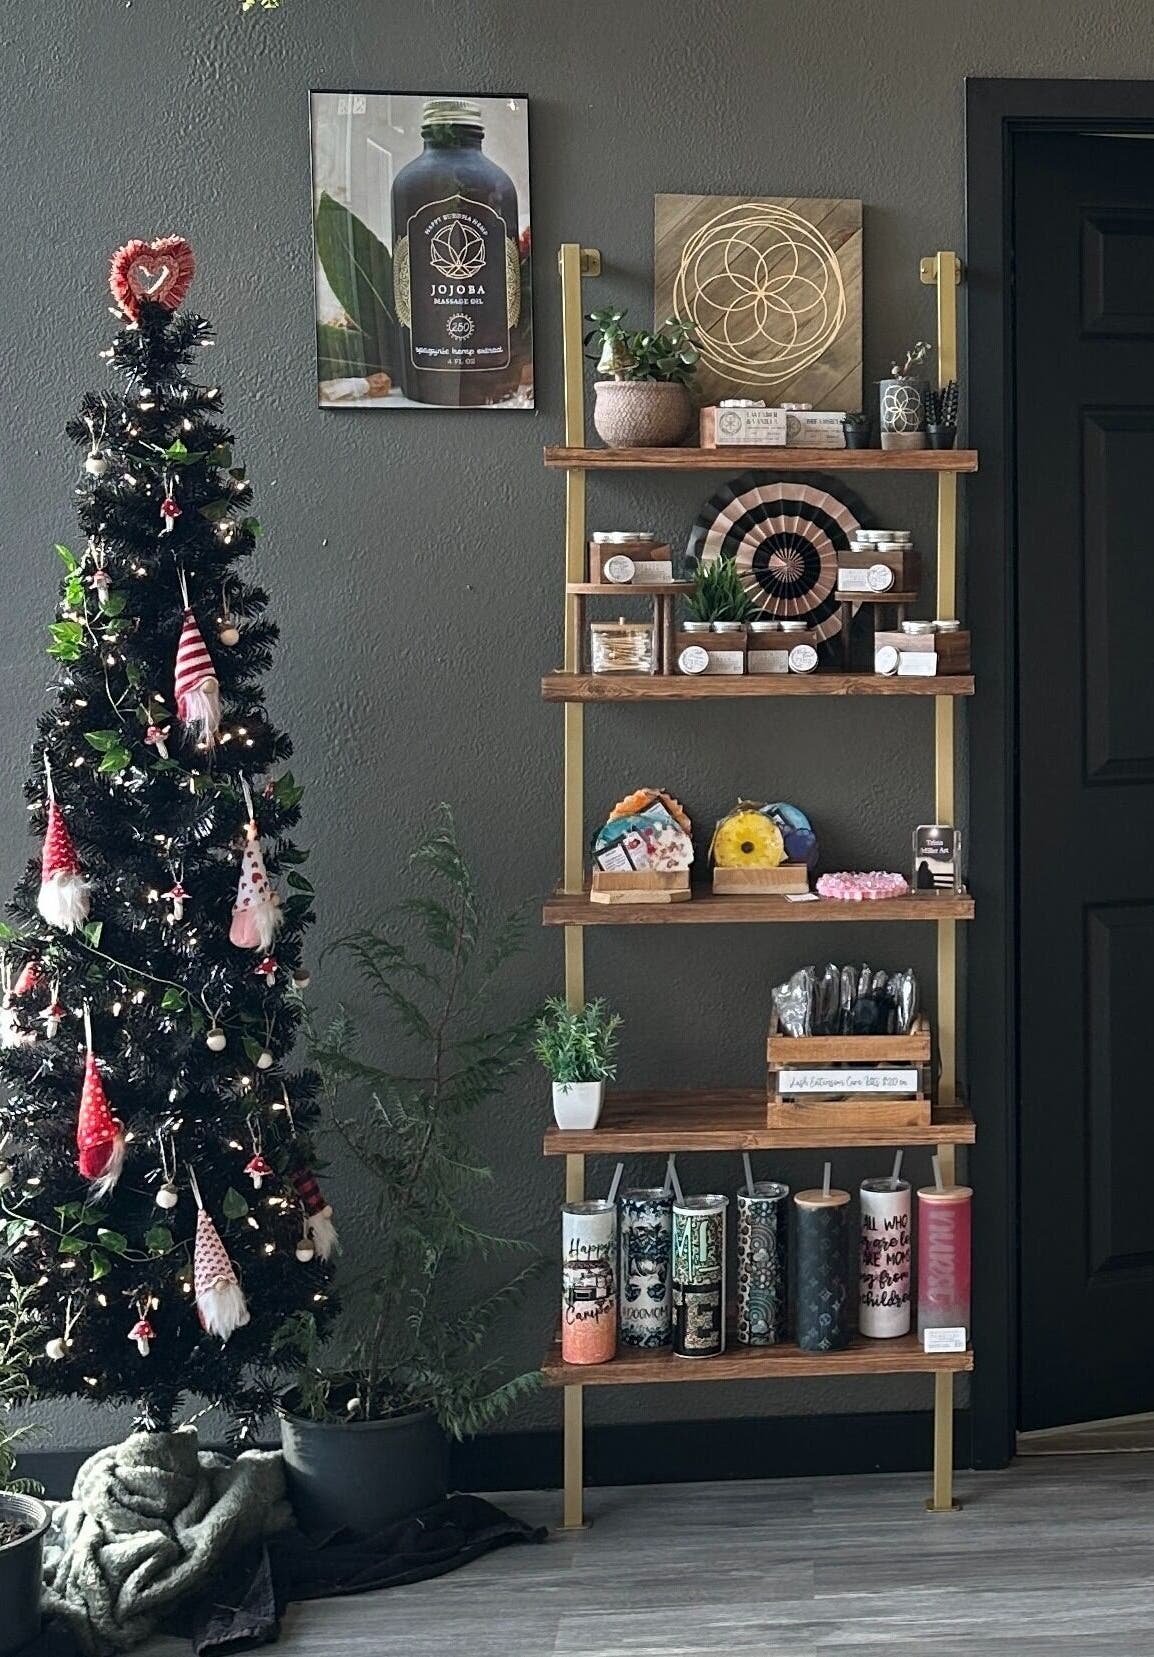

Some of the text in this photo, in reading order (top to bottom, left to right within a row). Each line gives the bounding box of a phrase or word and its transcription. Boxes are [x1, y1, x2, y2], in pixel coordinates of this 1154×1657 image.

[430, 284, 486, 297] JOJOBA
[451, 322, 470, 333] 250
[451, 346, 475, 357] hemp
[884, 1213, 908, 1231] WHO
